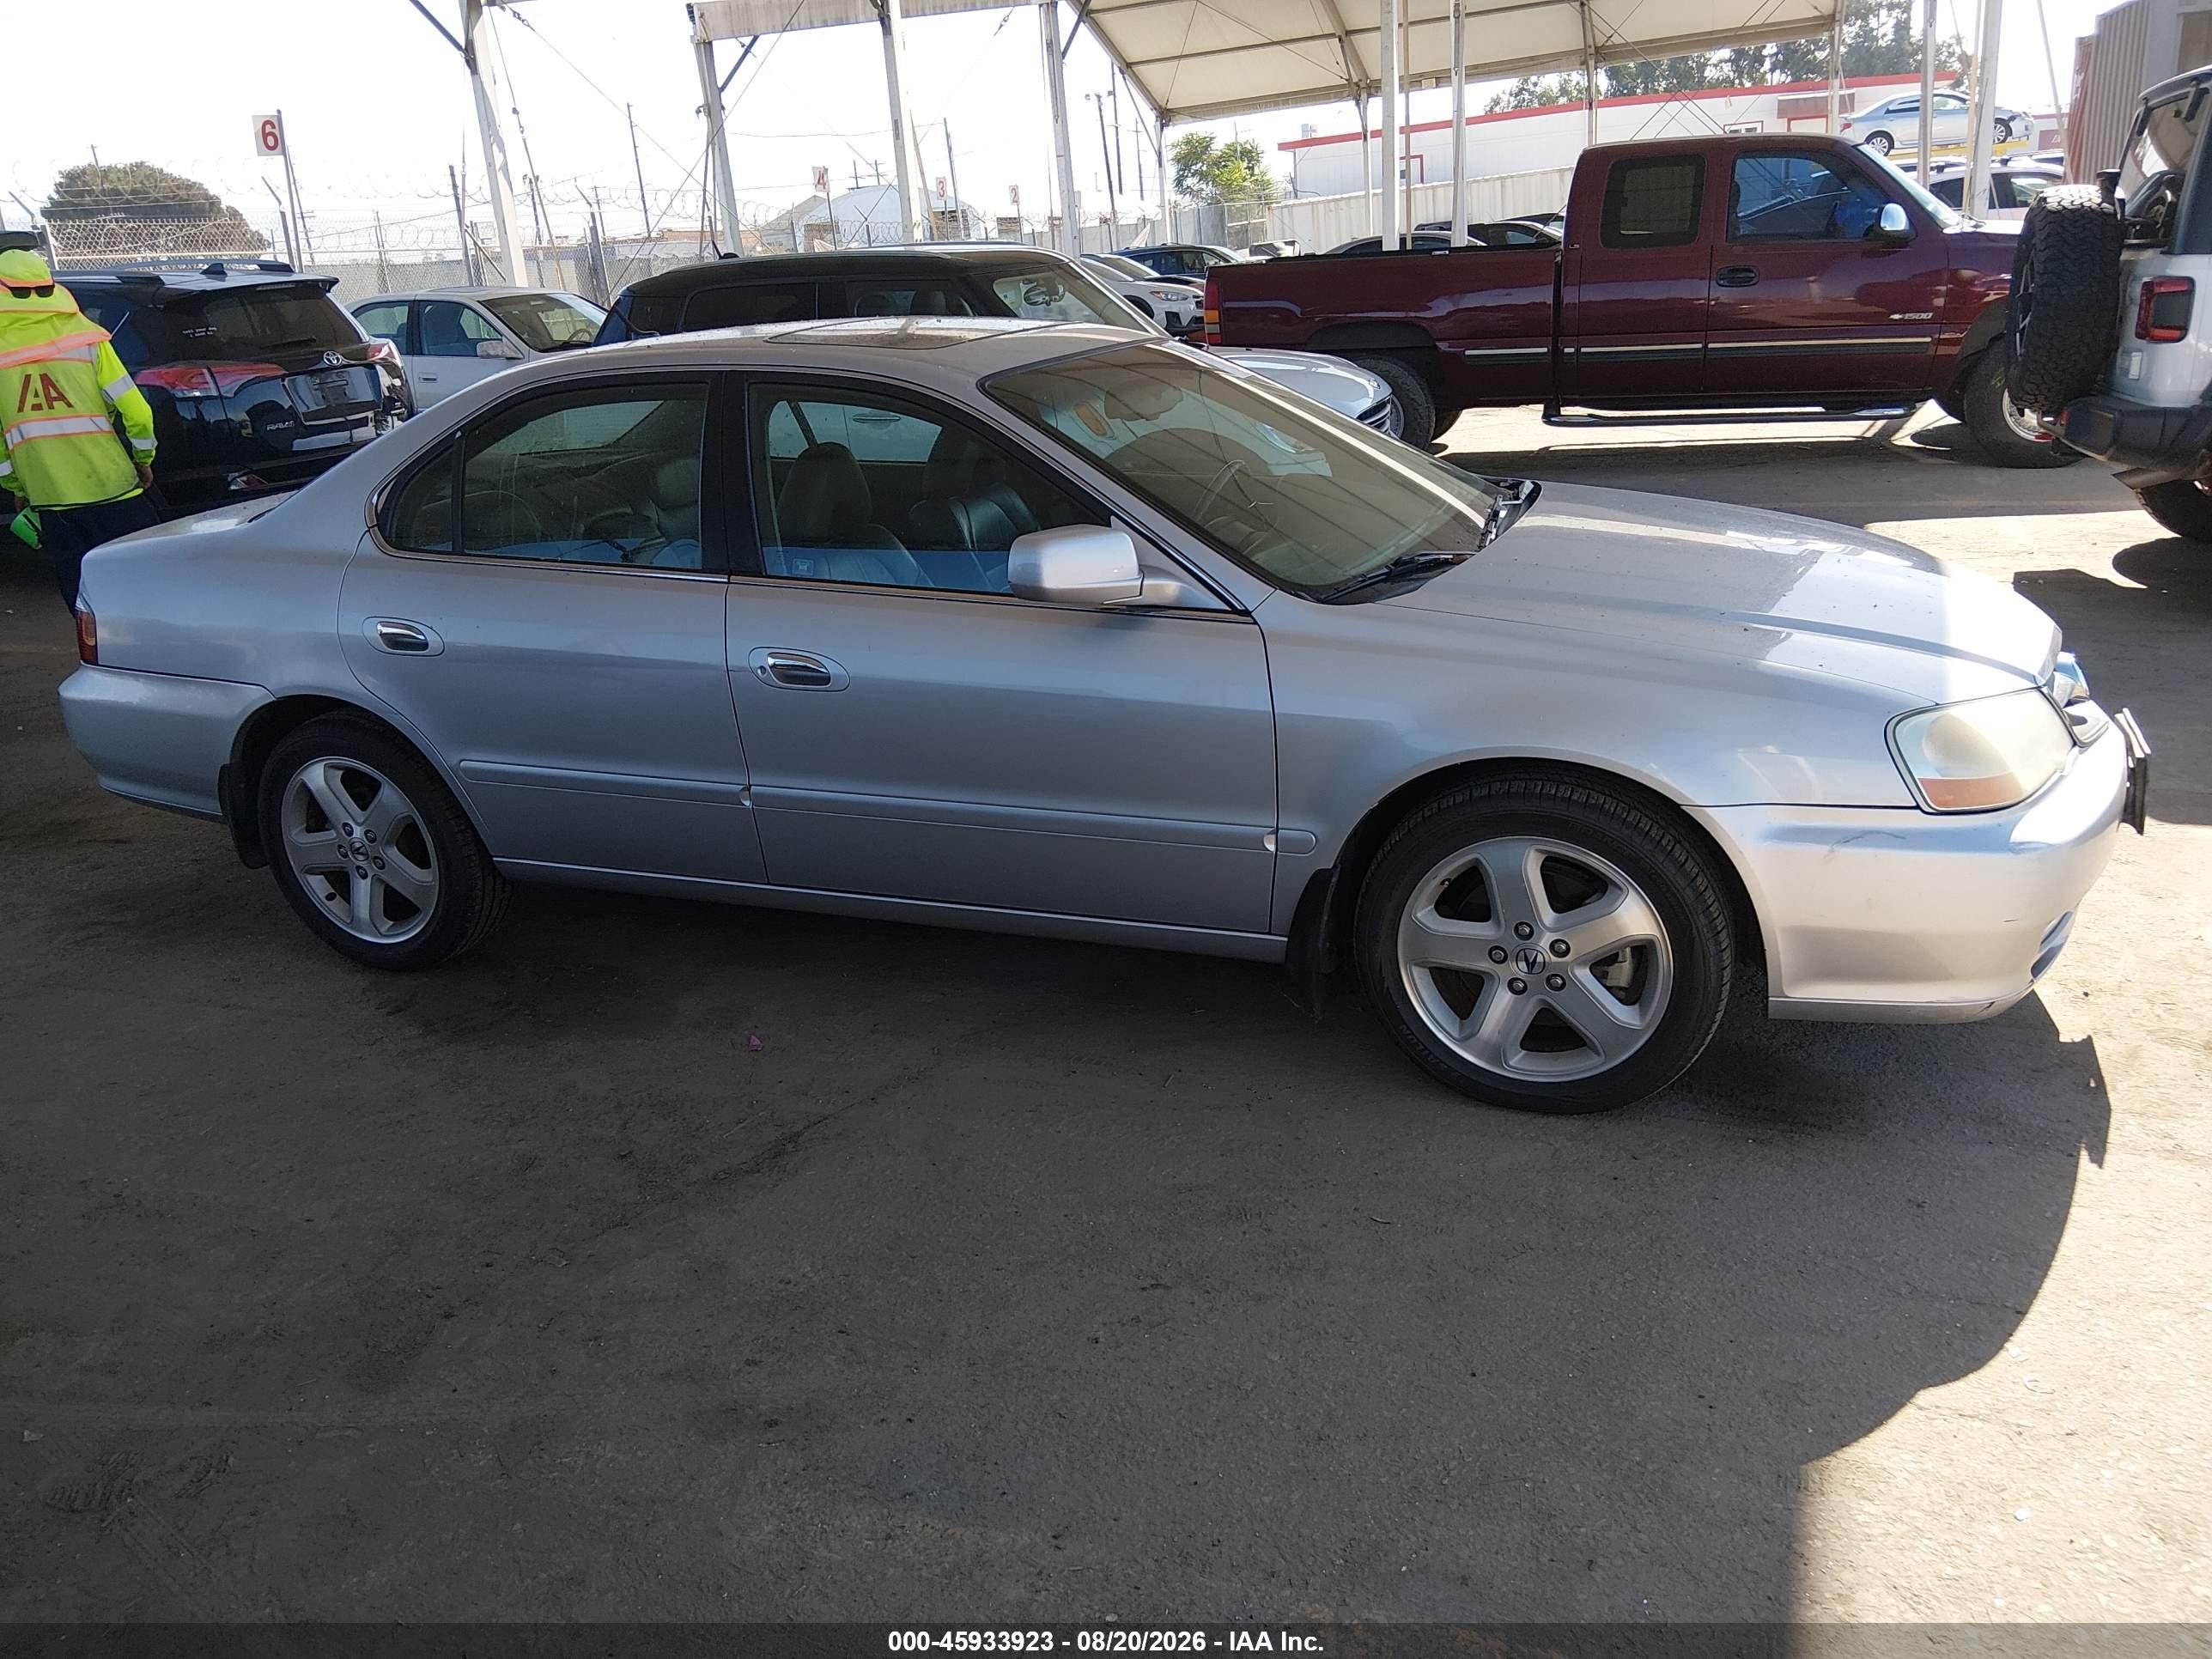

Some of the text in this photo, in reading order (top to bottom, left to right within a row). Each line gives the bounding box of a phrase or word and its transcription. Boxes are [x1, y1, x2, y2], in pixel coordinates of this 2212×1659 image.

[261, 119, 279, 151] 6
[817, 170, 826, 190] 4
[938, 180, 945, 198] 3
[1011, 187, 1018, 204] 2
